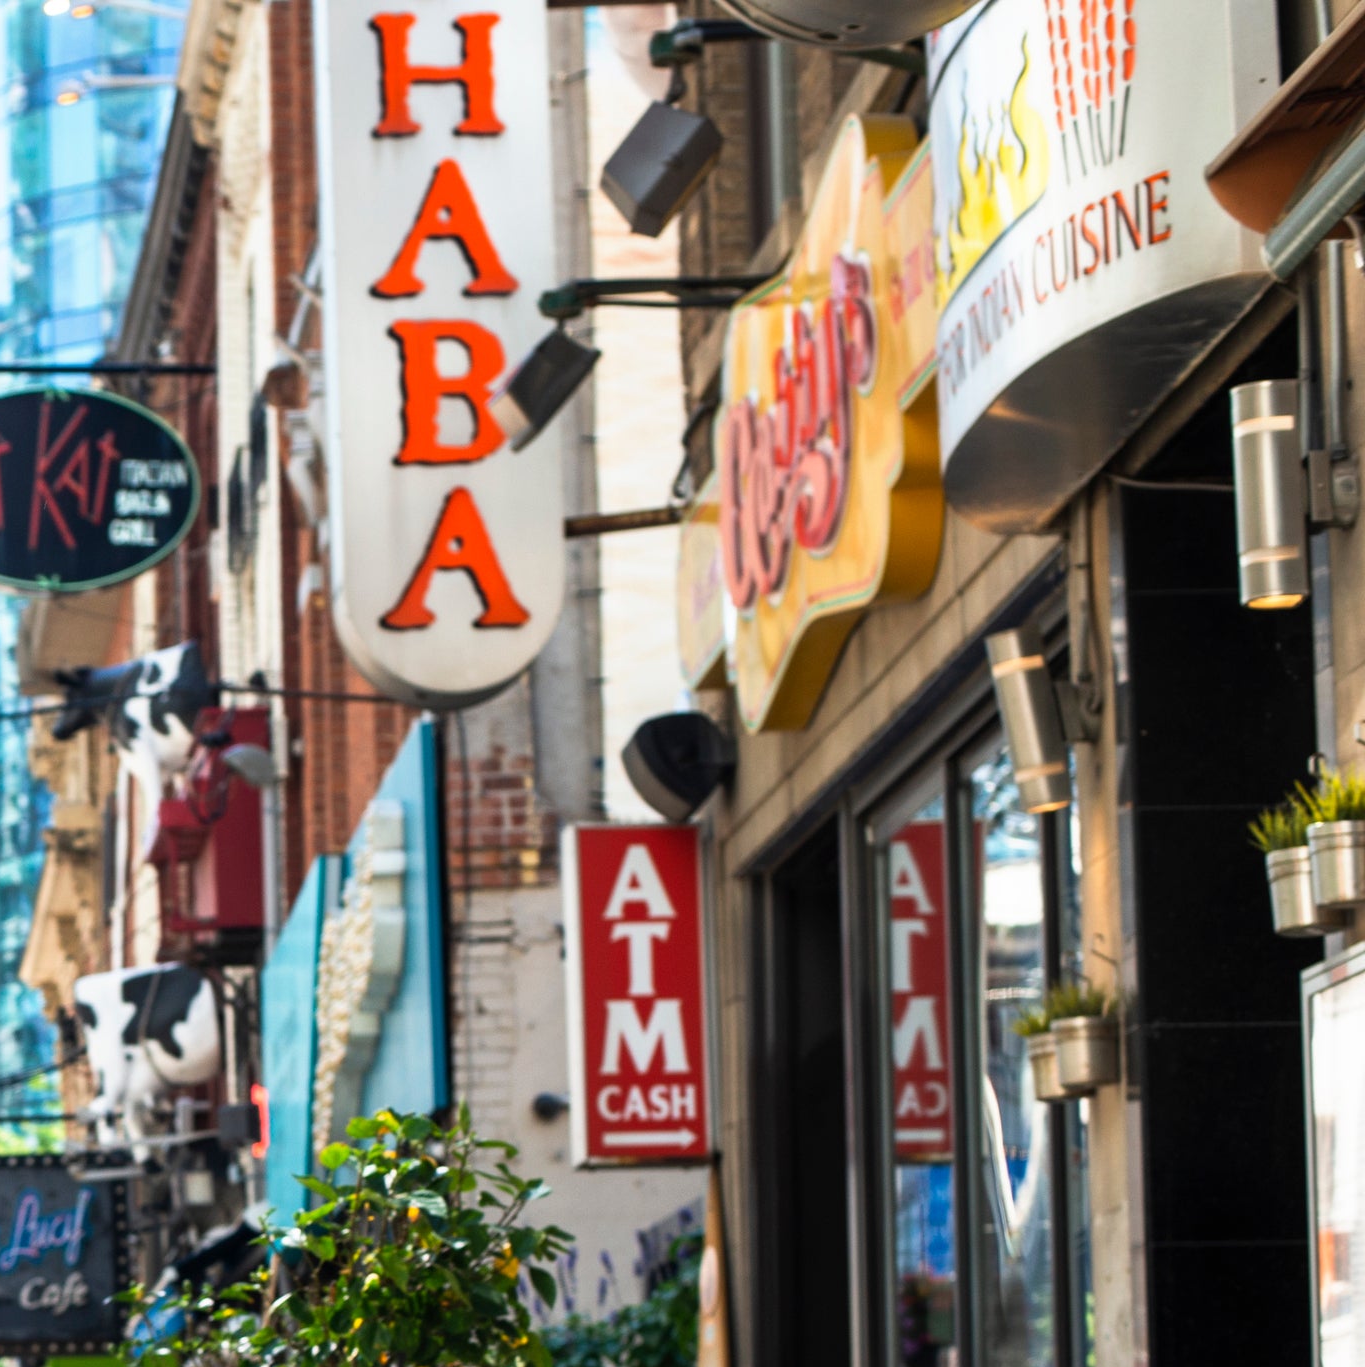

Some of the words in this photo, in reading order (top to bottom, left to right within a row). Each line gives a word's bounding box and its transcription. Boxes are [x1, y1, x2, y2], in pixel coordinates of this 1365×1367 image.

[369, 12, 531, 630] HABA
[1032, 169, 1173, 305] CUISINE
[600, 844, 691, 1075] ATM
[596, 1084, 697, 1122] CASH
